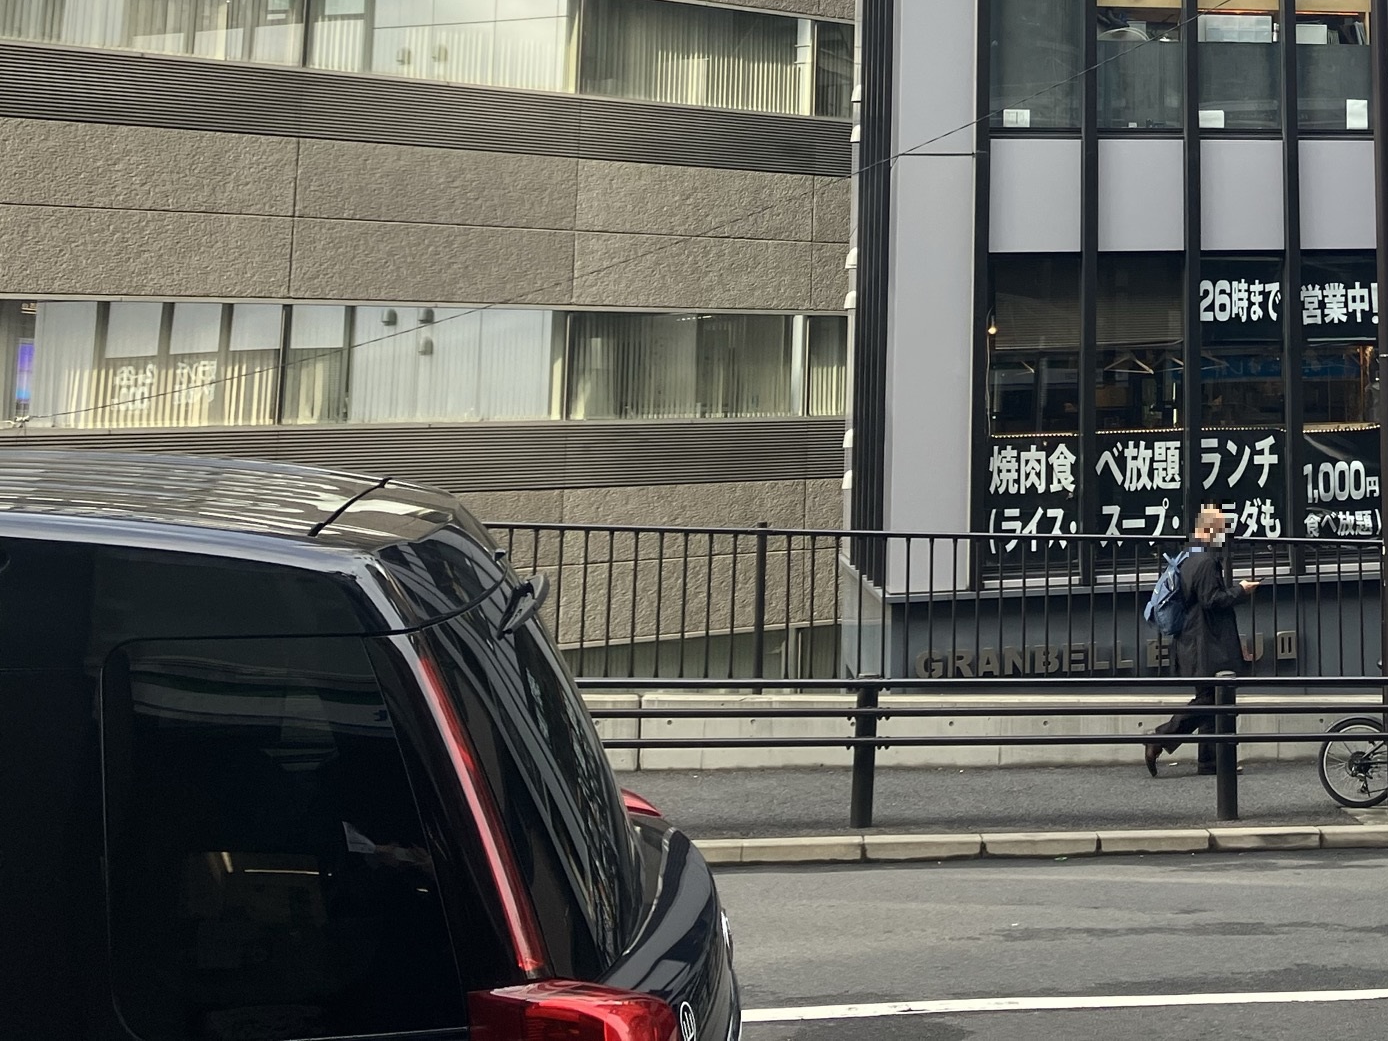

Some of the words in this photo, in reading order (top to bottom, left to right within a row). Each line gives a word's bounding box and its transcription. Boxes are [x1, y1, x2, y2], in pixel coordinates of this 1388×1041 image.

[1200, 279, 1281, 323] 26時まで
[988, 443, 1077, 495] 焼肉食
[1095, 440, 1182, 491] べ放題
[1201, 435, 1279, 489] ランチ
[1303, 460, 1380, 504] 1,000円
